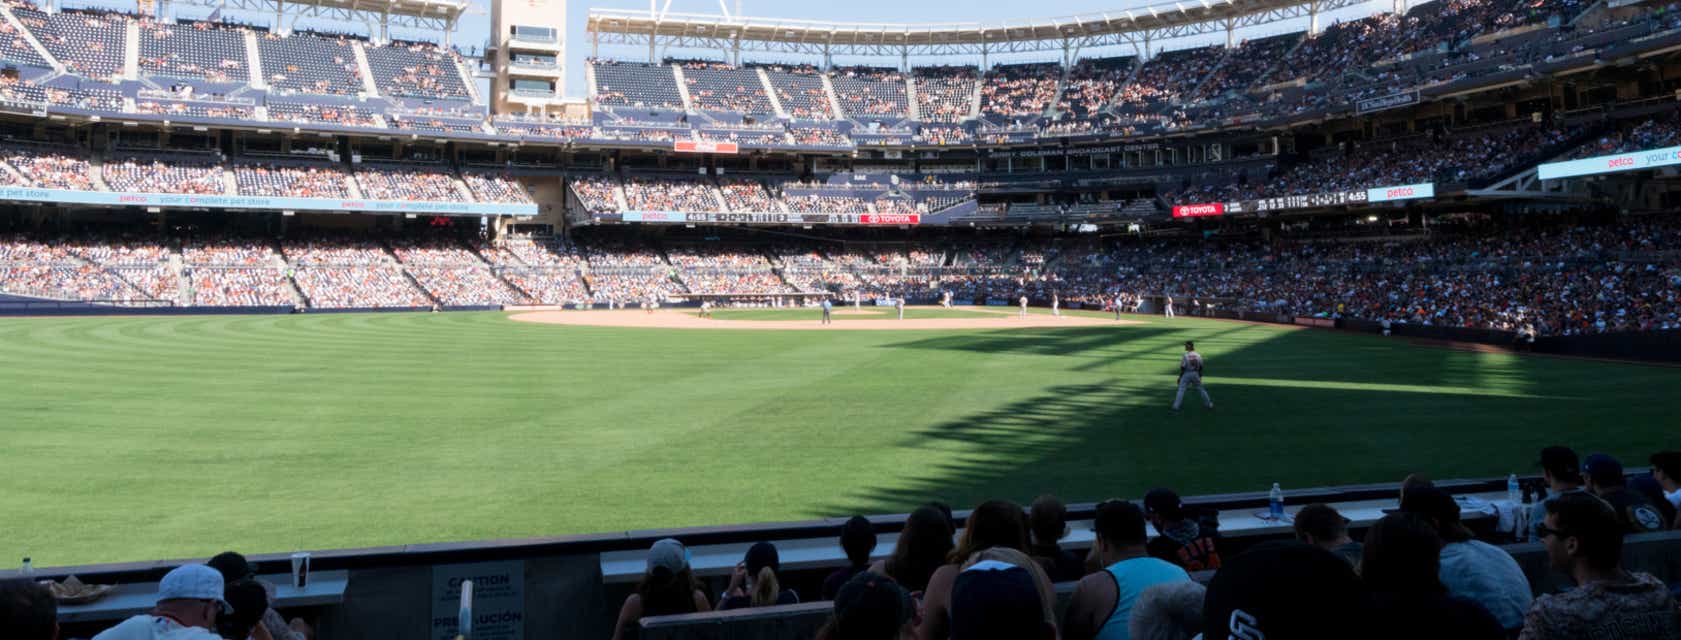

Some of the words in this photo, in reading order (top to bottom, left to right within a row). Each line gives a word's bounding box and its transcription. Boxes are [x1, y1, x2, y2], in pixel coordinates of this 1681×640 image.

[1608, 157, 1634, 168] petco
[1647, 152, 1668, 165] your
[26, 190, 49, 198] store
[1348, 191, 1366, 201] 4:55
[1386, 187, 1413, 199] petco
[120, 195, 147, 203] petco
[1189, 205, 1216, 214] TOYOTA
[880, 215, 910, 223] TOYOTA
[448, 575, 509, 588] CATION
[433, 611, 522, 626] PREUCIÓN
